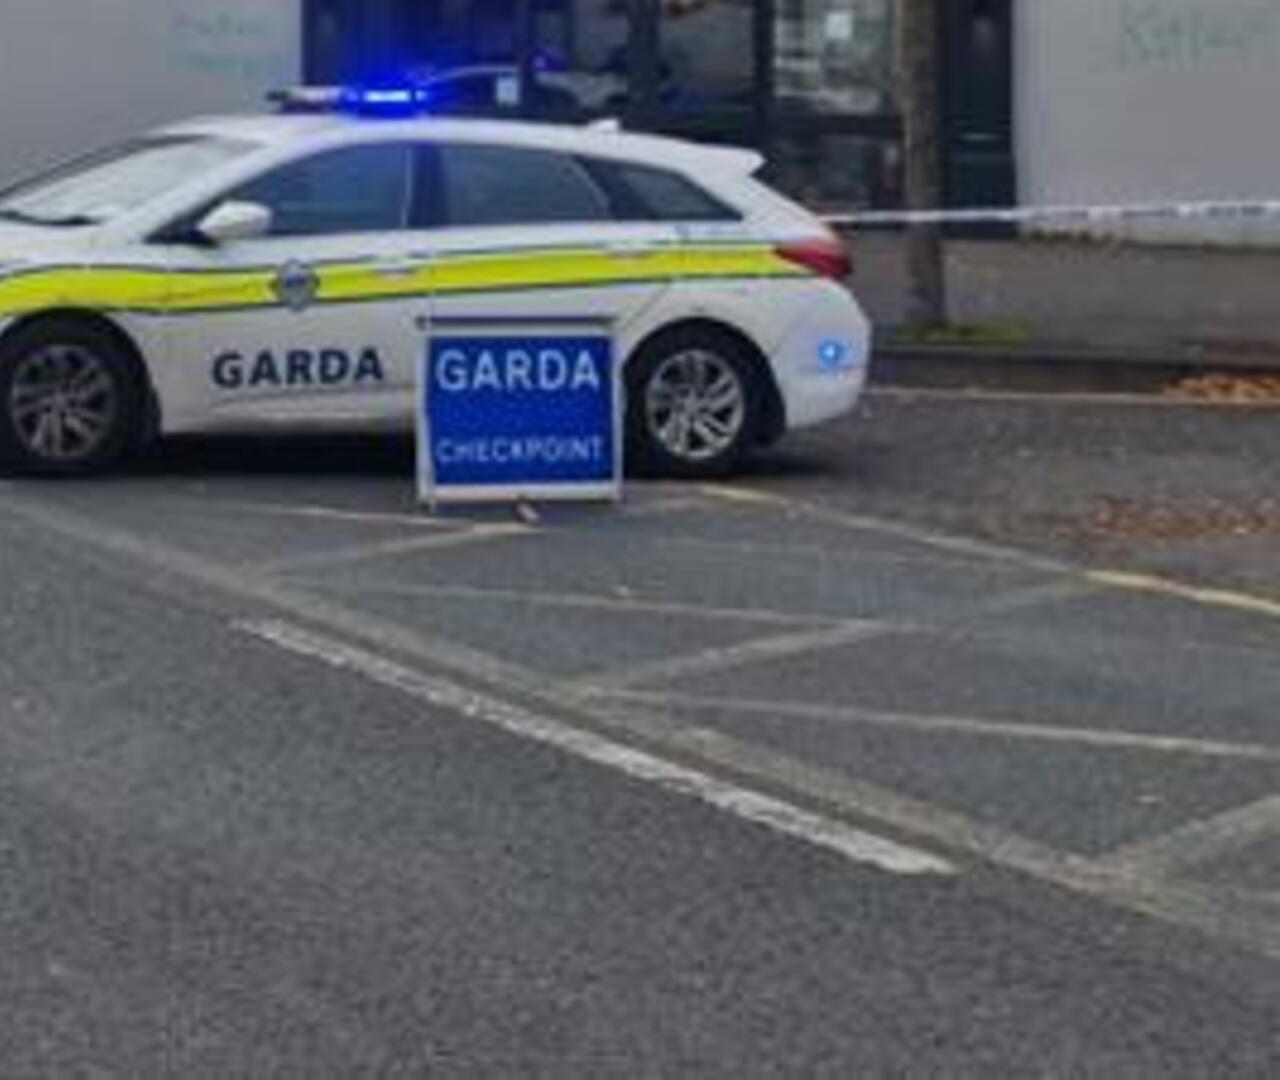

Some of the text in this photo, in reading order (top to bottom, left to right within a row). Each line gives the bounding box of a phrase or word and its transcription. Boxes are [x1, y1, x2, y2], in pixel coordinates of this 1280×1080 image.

[211, 348, 385, 388] GARDA
[437, 349, 601, 391] GARDA
[437, 436, 602, 464] CHECKPOINT
